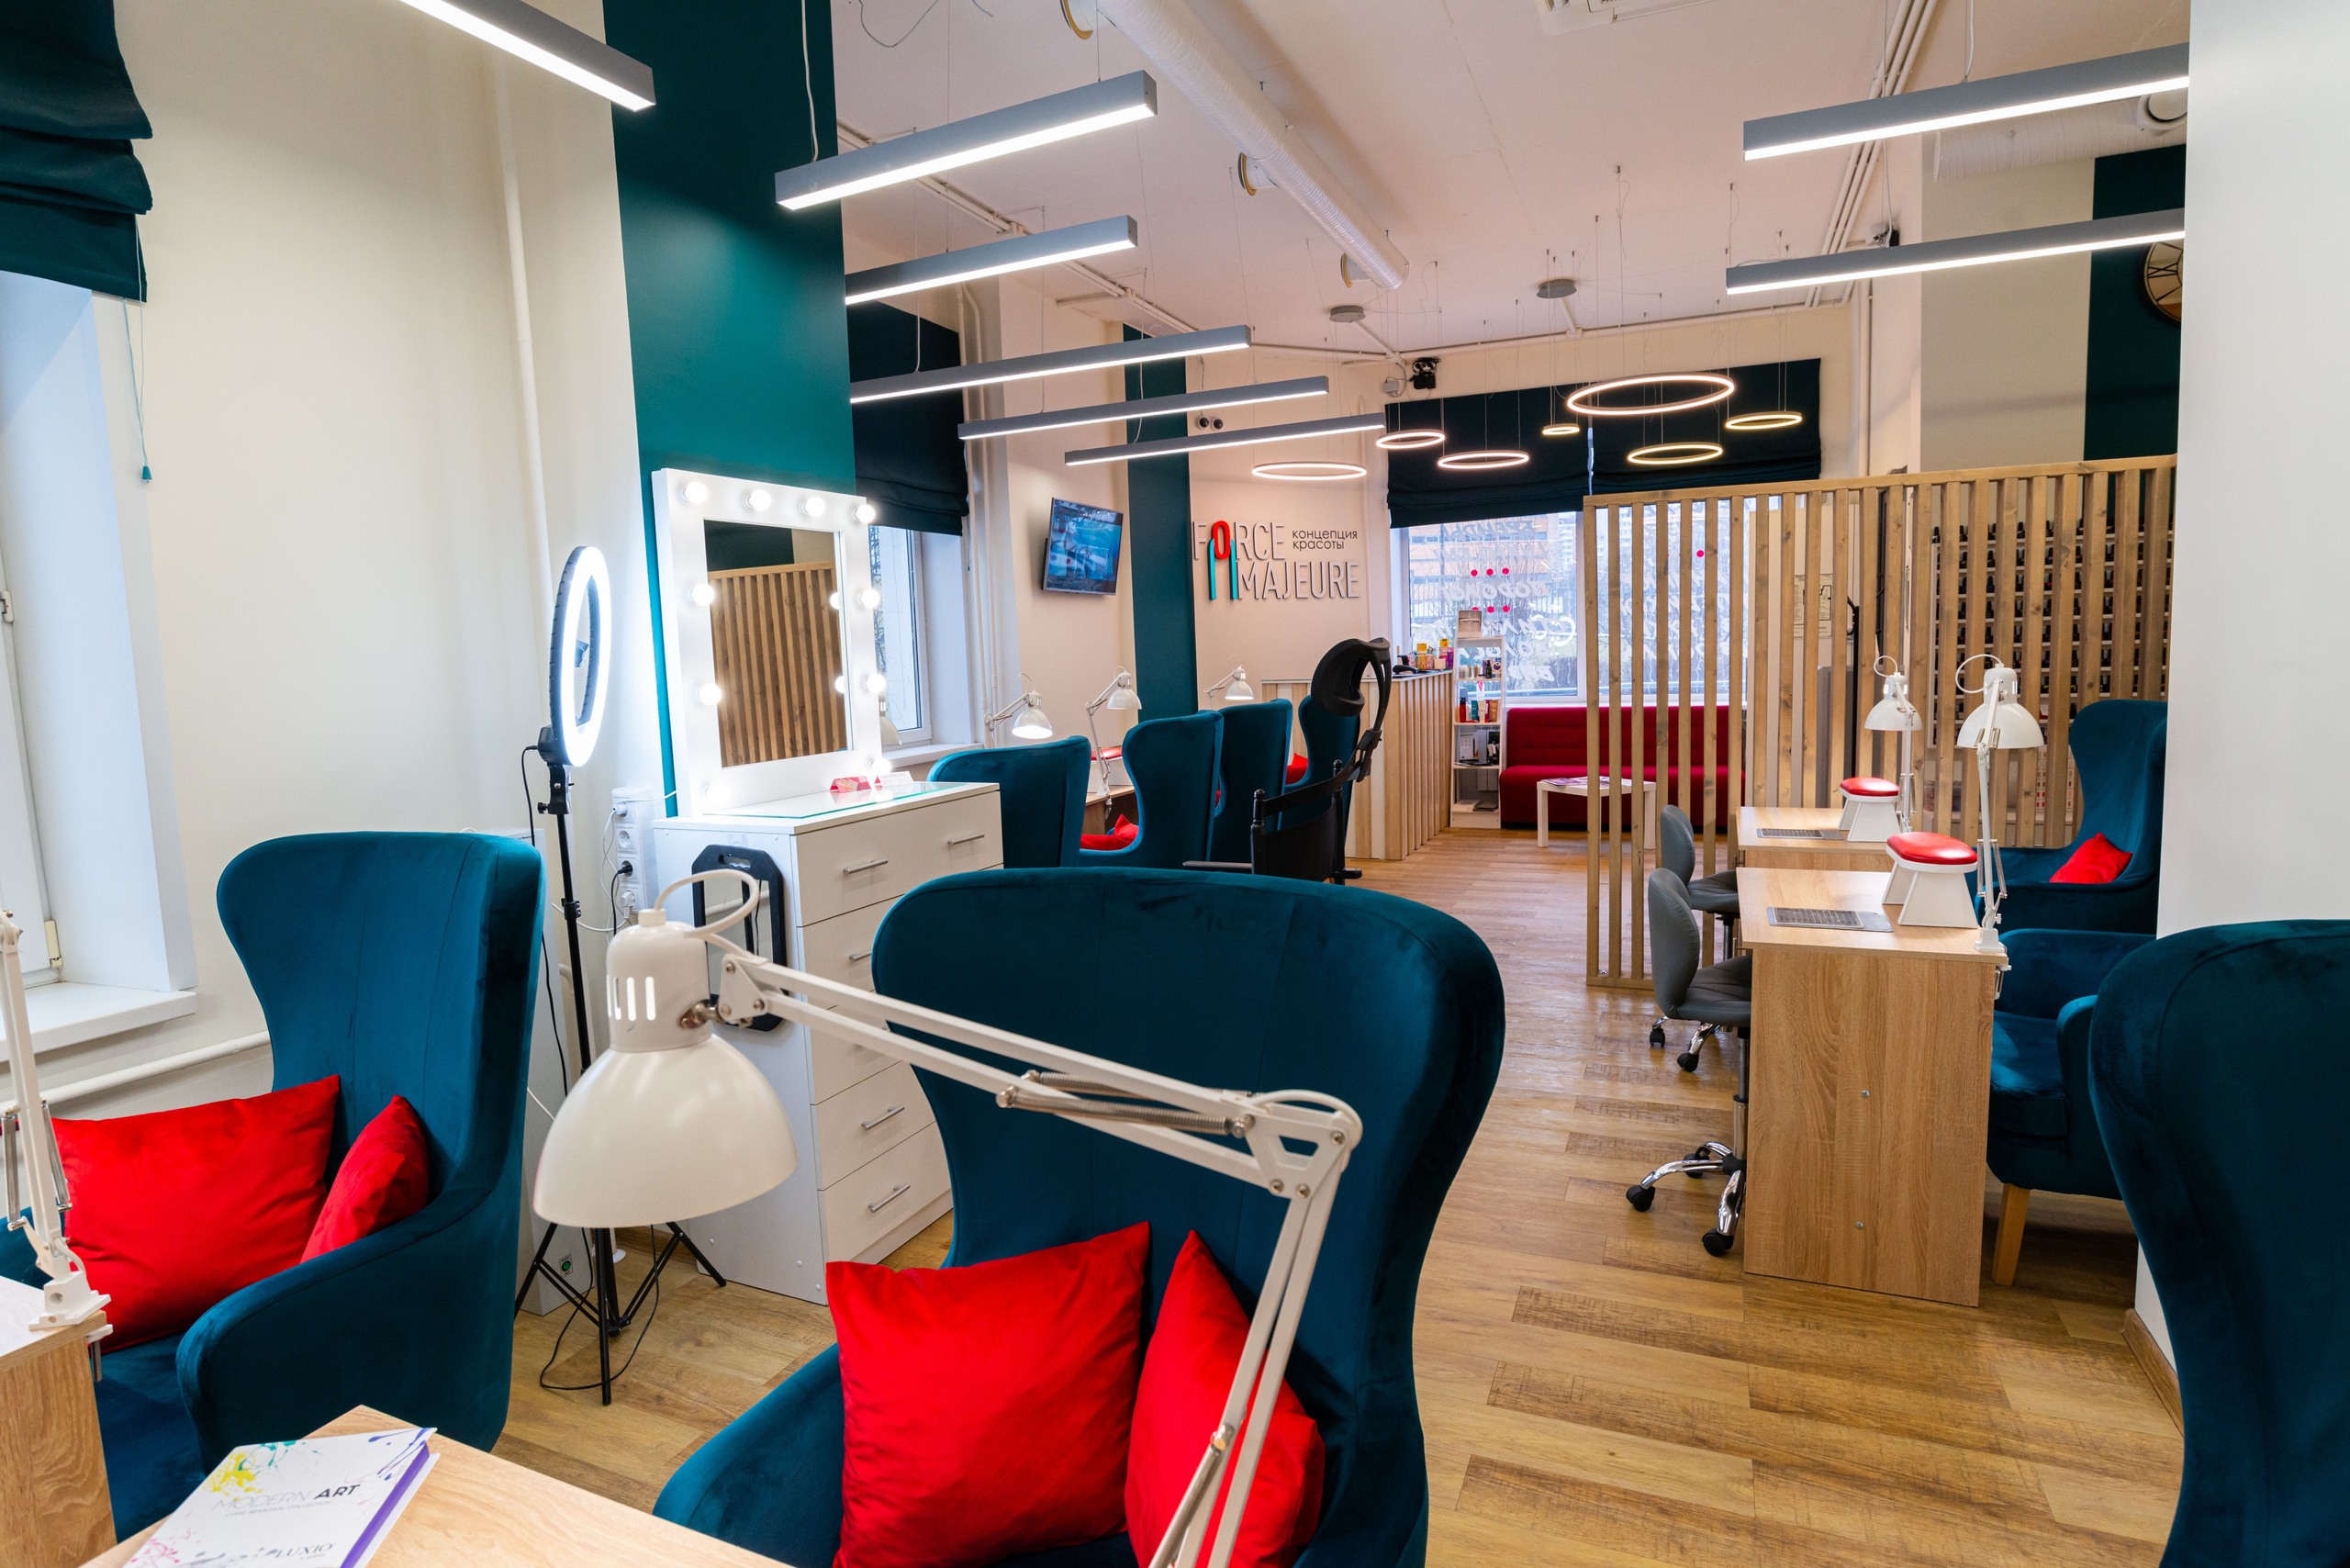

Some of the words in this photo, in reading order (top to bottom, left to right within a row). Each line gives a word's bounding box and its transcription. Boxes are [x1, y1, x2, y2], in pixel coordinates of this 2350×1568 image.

[1192, 520, 1285, 560] FORCE
[1292, 529, 1358, 541] концепция
[1292, 539, 1345, 552] красоты
[1237, 561, 1360, 599] MAJEURE
[212, 1491, 312, 1511] MODERN
[314, 1484, 360, 1500] ART
